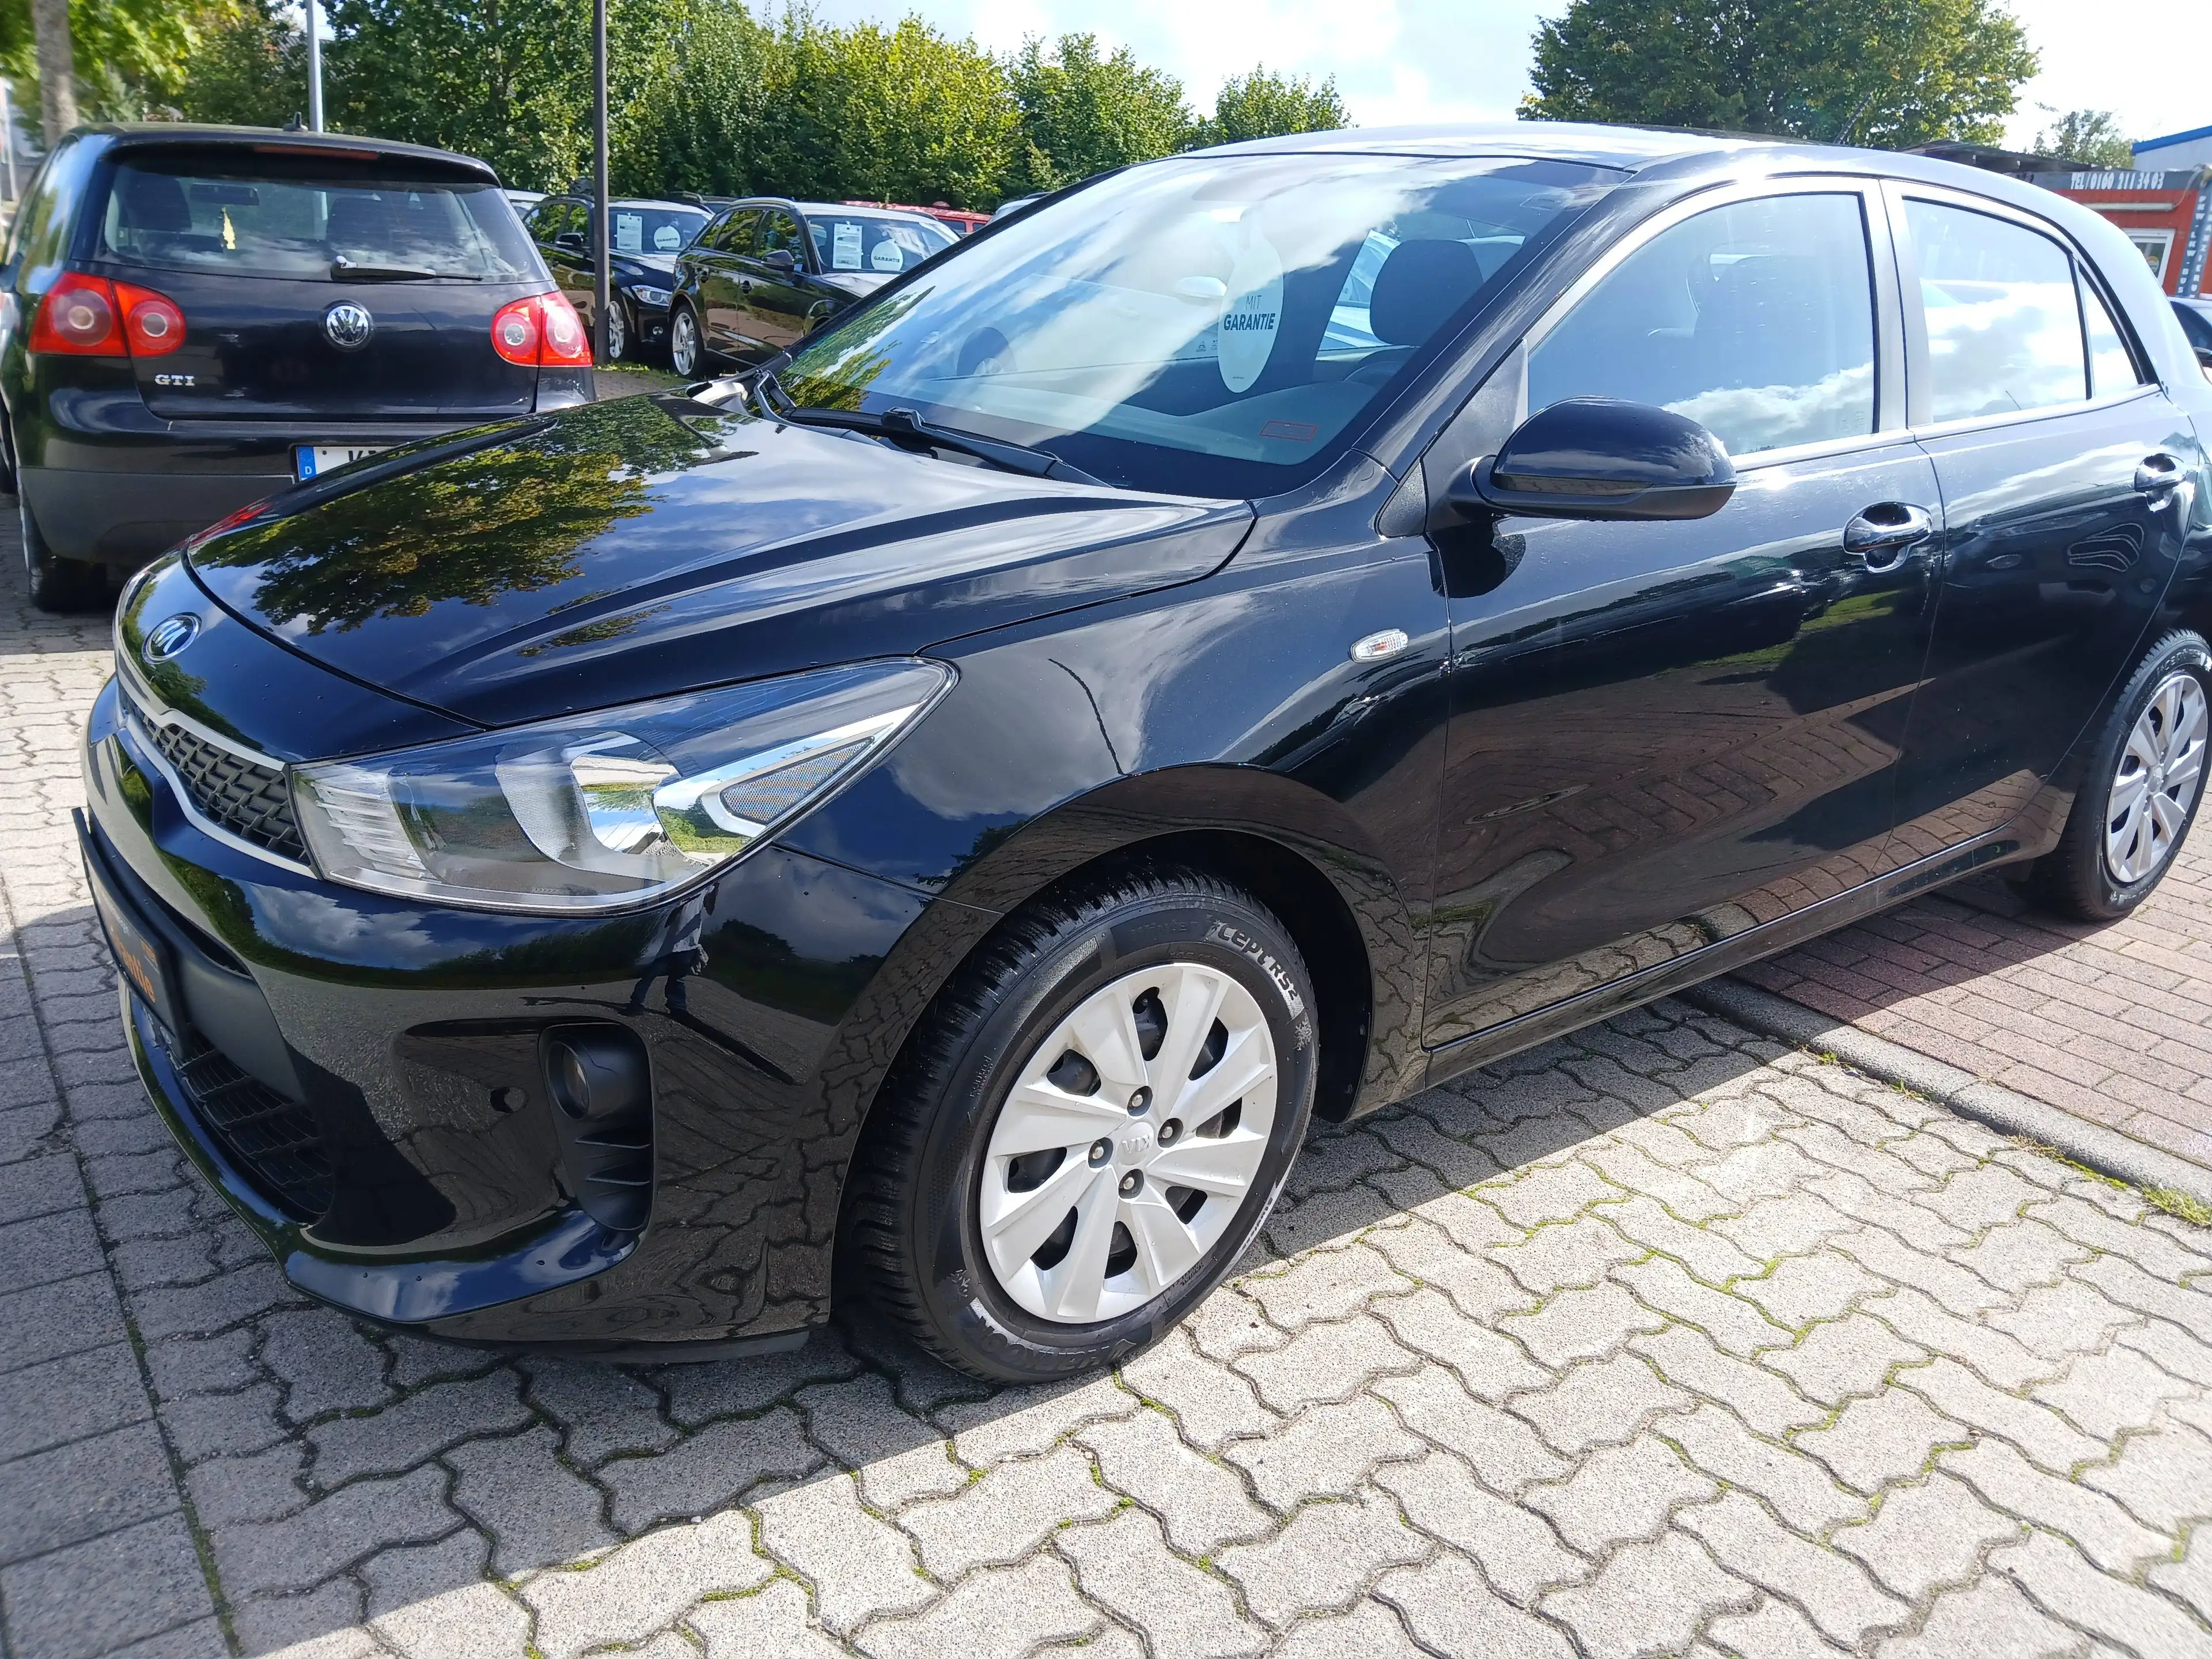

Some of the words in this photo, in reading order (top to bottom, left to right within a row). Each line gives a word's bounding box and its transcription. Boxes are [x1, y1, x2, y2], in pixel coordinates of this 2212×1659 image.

[1245, 295, 1262, 310] MIT
[1224, 313, 1276, 331] GARANTIE
[155, 374, 195, 386] GTI
[304, 465, 312, 475] D
